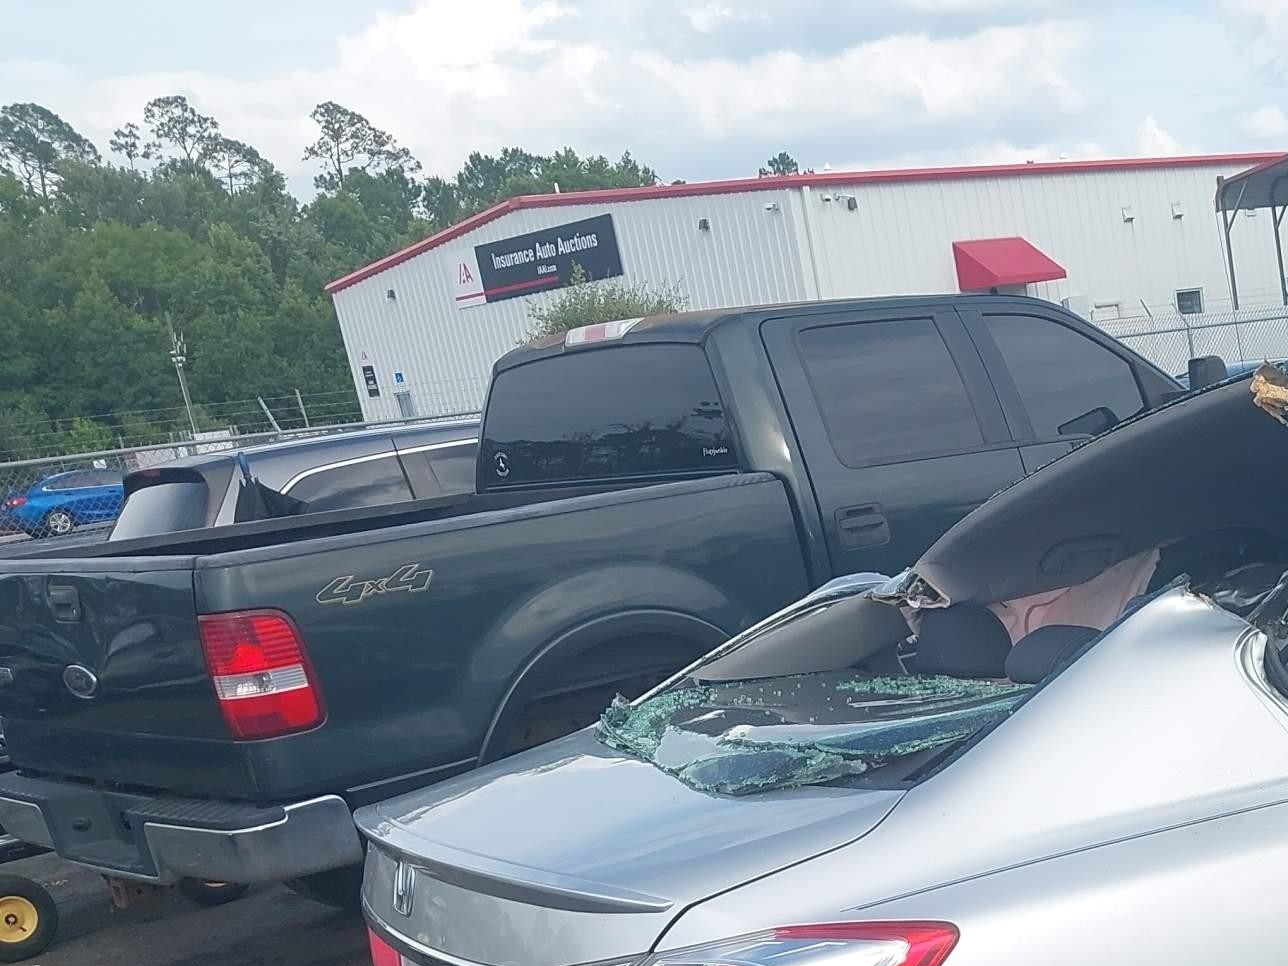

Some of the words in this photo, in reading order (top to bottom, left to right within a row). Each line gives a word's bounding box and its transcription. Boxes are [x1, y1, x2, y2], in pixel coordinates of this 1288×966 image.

[491, 249, 535, 270] Insurance
[535, 242, 557, 261] Auto
[557, 232, 598, 256] Auctions
[315, 563, 433, 604] 4x4
